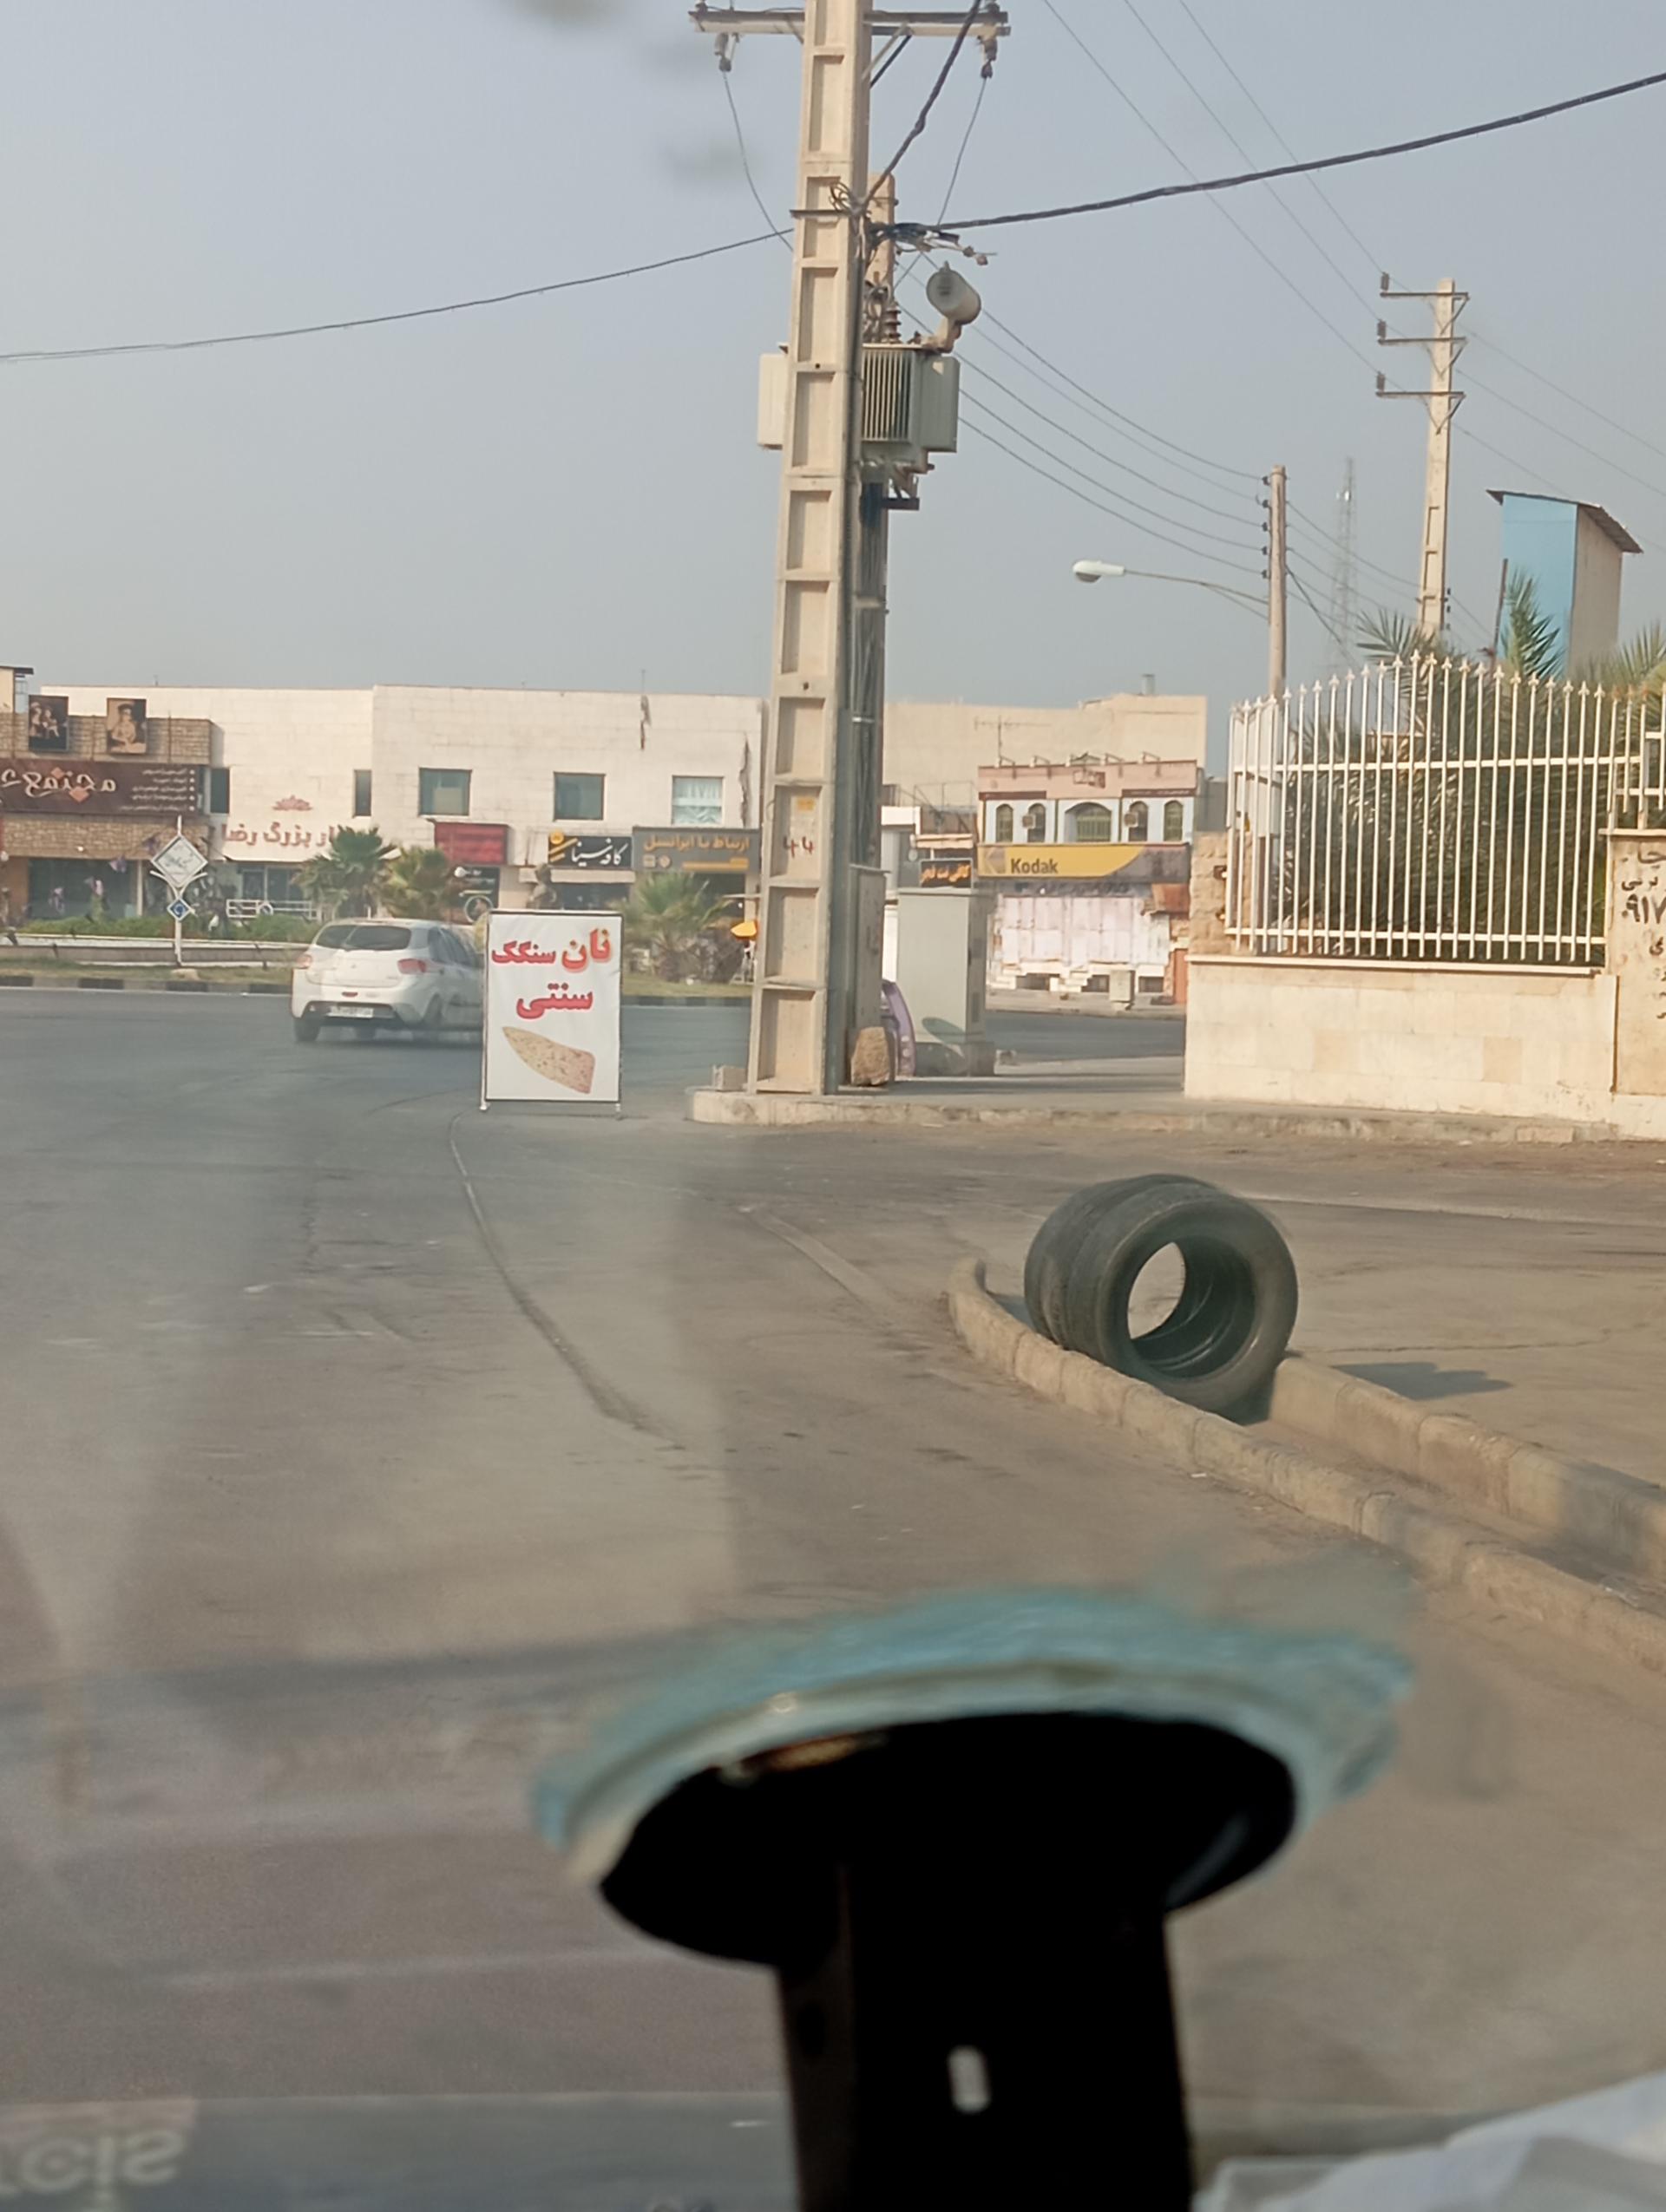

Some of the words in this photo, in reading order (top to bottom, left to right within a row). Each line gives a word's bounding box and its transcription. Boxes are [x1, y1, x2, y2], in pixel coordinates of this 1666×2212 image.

[222, 823, 258, 846] رضا
[263, 821, 312, 847] بزرگ
[1010, 858, 1059, 874] Kodak
[562, 928, 613, 971] نان
[516, 983, 594, 1019] سنتی
